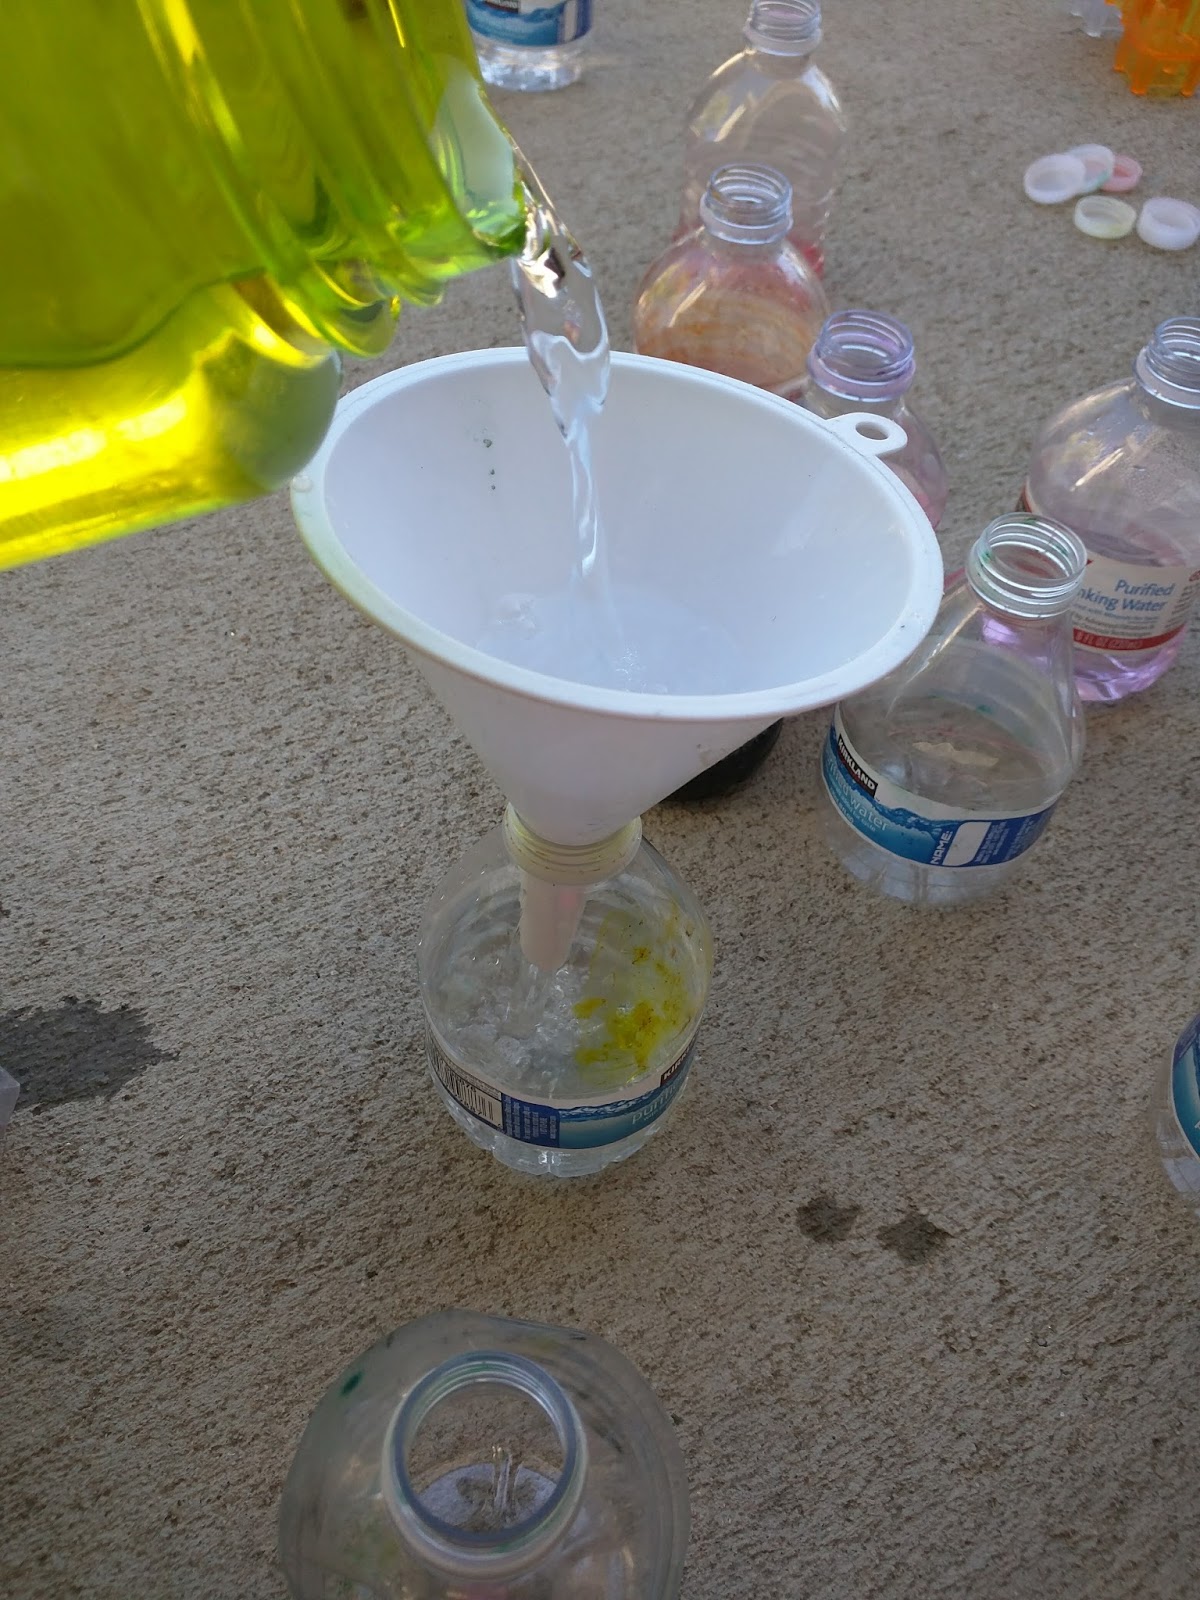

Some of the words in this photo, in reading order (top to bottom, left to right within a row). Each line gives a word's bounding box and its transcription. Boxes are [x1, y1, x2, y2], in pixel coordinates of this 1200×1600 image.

[1077, 588, 1118, 610] nking
[1122, 598, 1169, 612] Water
[1115, 579, 1175, 596] Purified
[838, 739, 876, 791] KIRKLAND
[850, 796, 890, 832] water
[930, 830, 953, 866] NAME:
